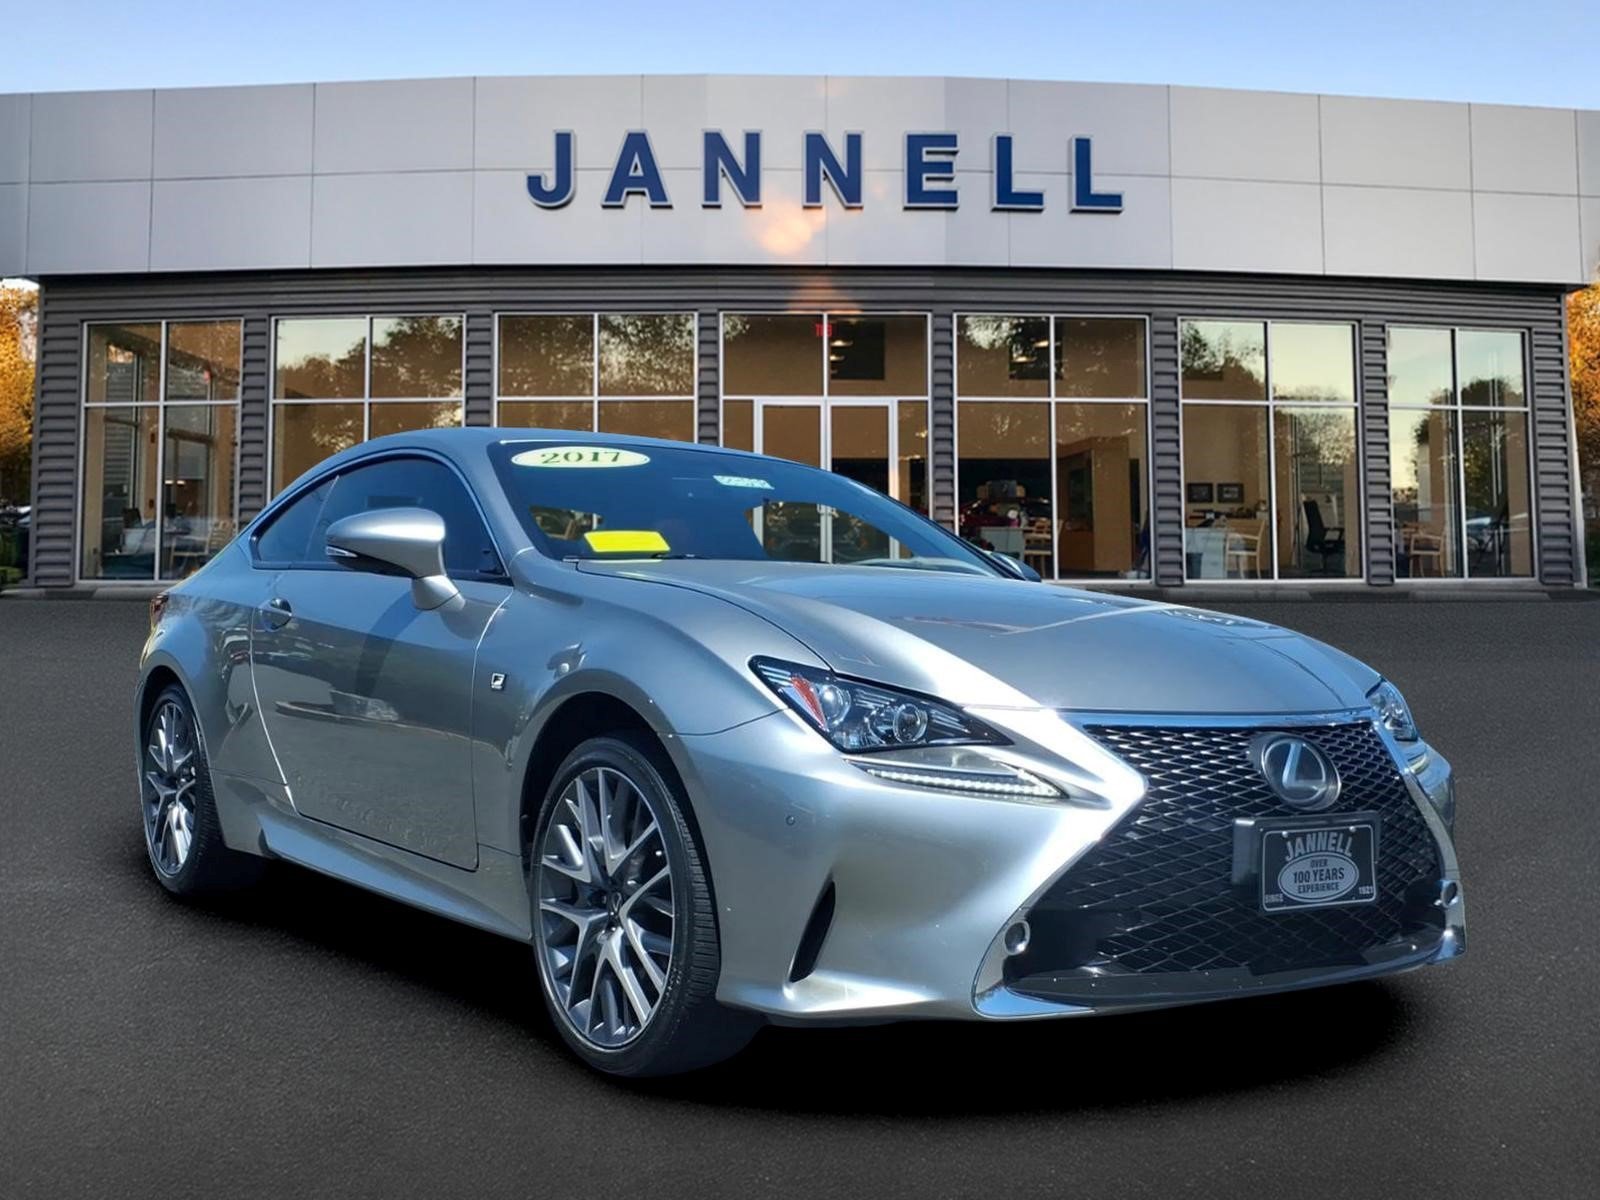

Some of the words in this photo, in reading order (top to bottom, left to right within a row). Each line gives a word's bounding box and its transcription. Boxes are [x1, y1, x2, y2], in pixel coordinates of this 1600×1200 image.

[526, 129, 1124, 214] JANNELL
[540, 451, 621, 464] 2017
[1285, 832, 1353, 862] JANNELL
[1310, 859, 1328, 868] OVER
[1293, 871, 1311, 884] 100
[1312, 867, 1345, 882] YEARS
[1297, 882, 1340, 894] EXPERIENCE
